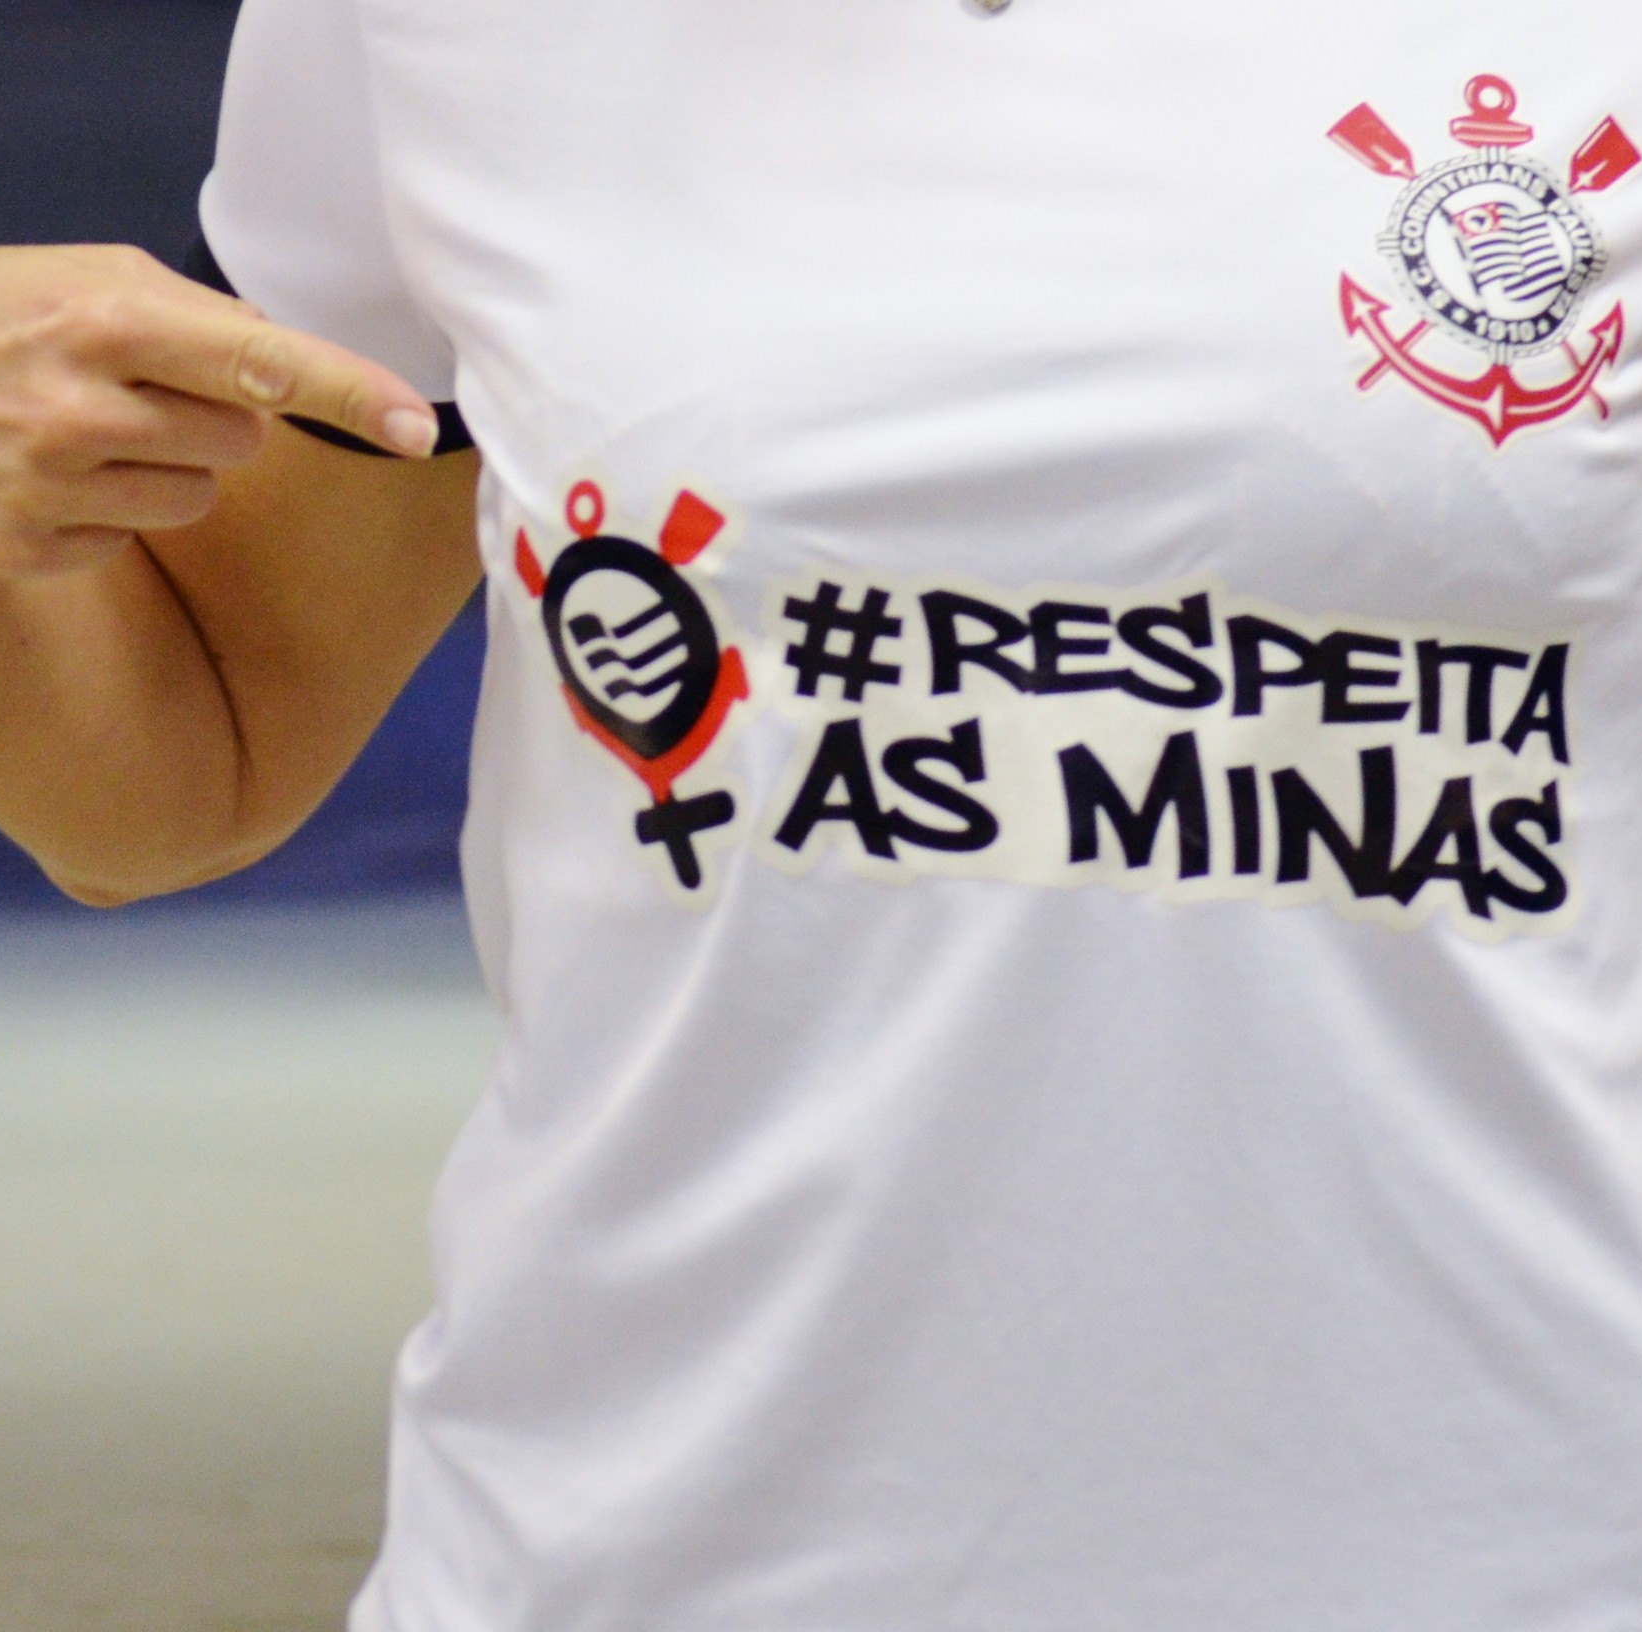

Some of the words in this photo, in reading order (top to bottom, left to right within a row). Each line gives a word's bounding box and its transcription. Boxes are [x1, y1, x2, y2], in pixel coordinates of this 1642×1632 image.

[1401, 164, 1548, 256] CORINTHIANS
[1475, 315, 1537, 344] 1910
[784, 581, 1570, 764] #RESPEITA
[774, 718, 999, 859] AS
[1058, 731, 1568, 919] MINAS
